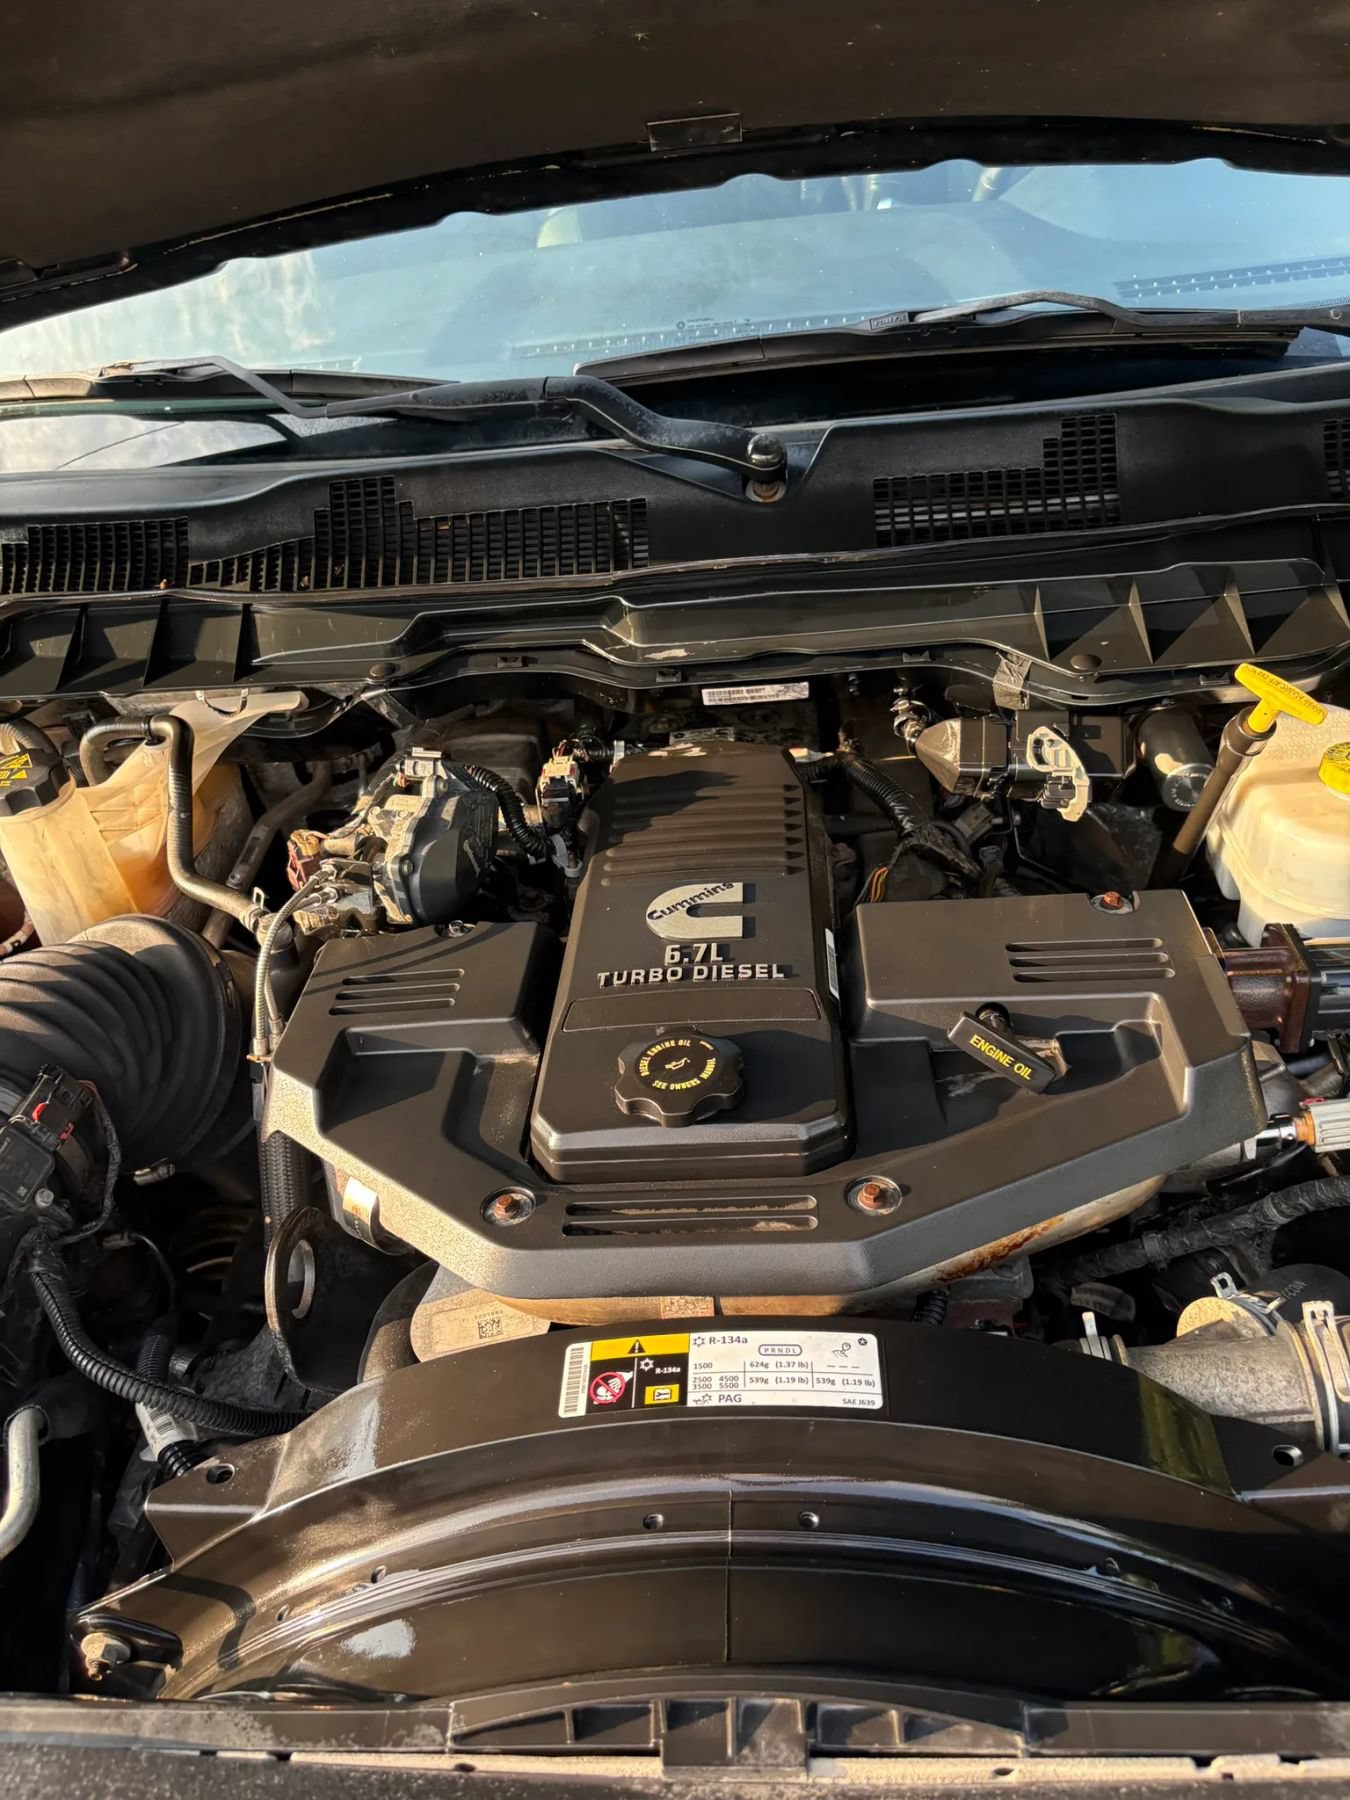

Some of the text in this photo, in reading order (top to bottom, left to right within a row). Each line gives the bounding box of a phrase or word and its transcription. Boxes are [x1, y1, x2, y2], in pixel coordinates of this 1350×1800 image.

[647, 882, 735, 920] Cummins
[664, 943, 723, 965] 6.7L
[597, 963, 785, 988] TURBO DIESEL
[647, 1040, 676, 1057] ENGINE
[678, 1039, 692, 1047] OIL
[969, 1034, 1033, 1080] ENGINE OIL
[652, 1080, 668, 1090] SEE
[670, 1078, 701, 1090] OWNERS
[708, 1335, 748, 1345] R-134a
[749, 1361, 770, 1369] 624g
[749, 1376, 769, 1385] 539g
[815, 1378, 836, 1386] 539g
[718, 1394, 742, 1403] PAG
